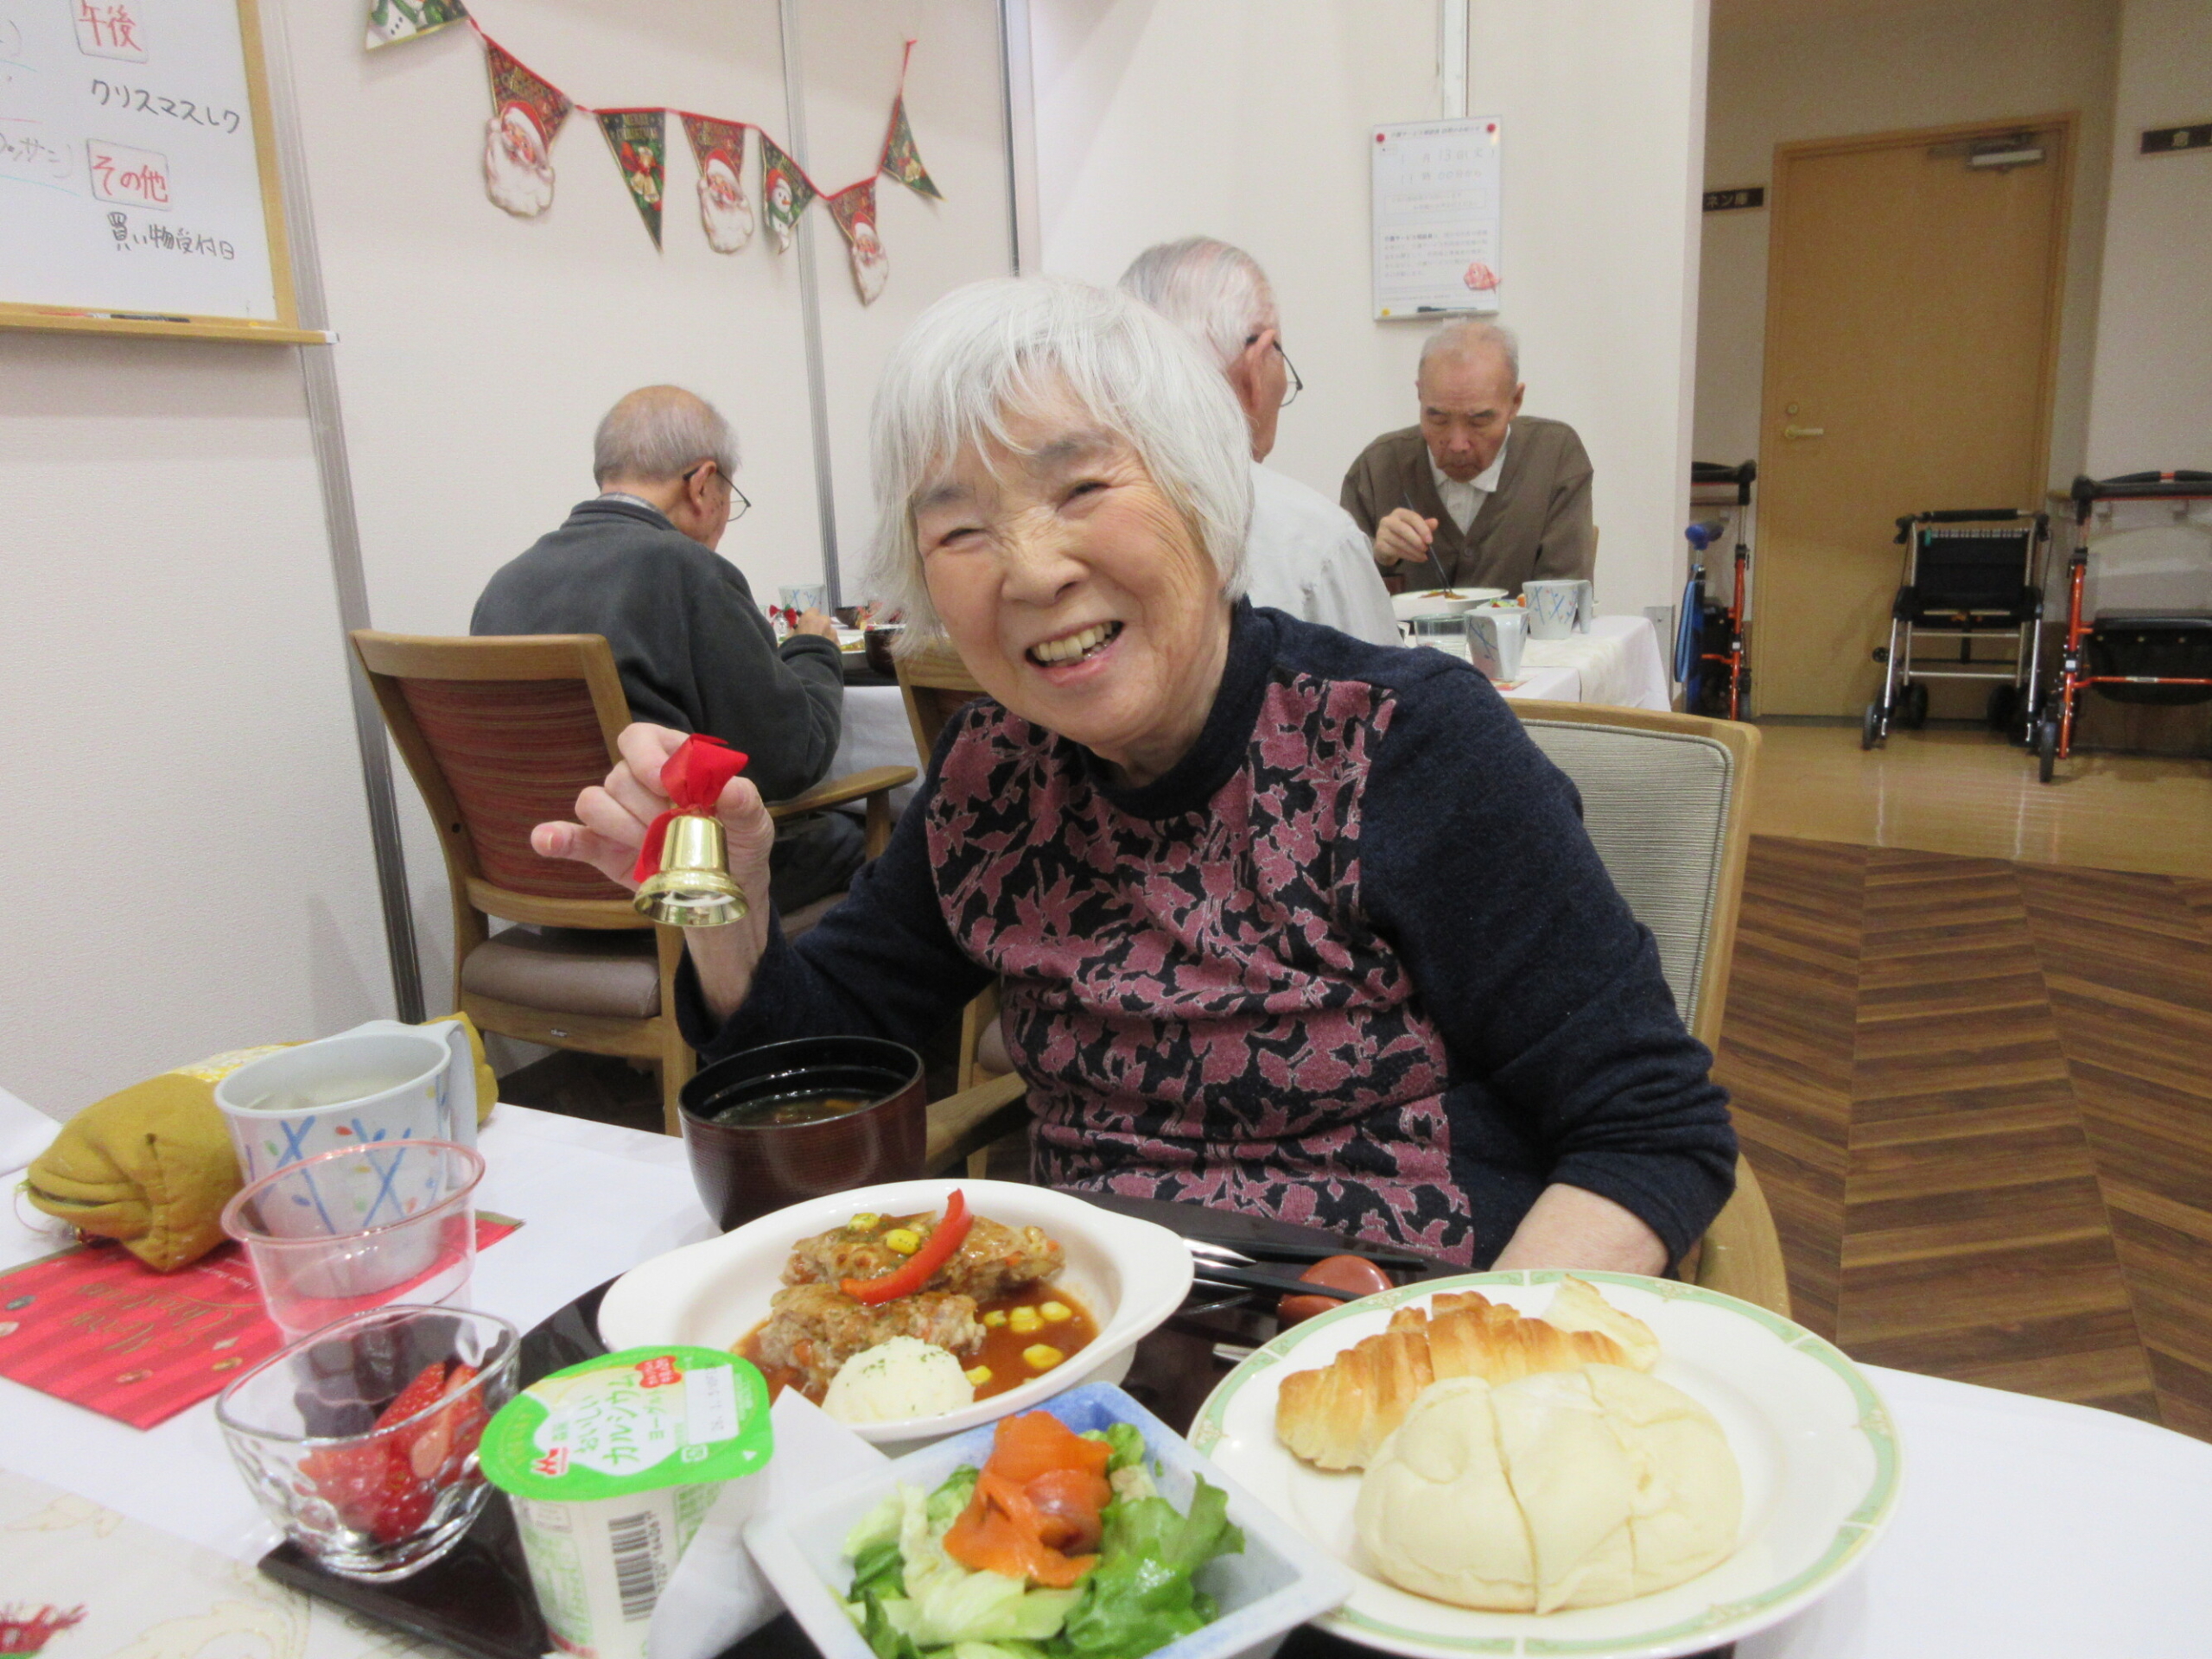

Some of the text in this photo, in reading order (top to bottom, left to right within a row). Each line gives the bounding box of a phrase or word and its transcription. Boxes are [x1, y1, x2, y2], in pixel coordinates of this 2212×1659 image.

[78, 0, 143, 52] 午後
[92, 155, 169, 204] その他
[107, 211, 236, 261] 買い物受付日
[574, 1394, 603, 1454] おいしい
[601, 1372, 641, 1465] カルシウム
